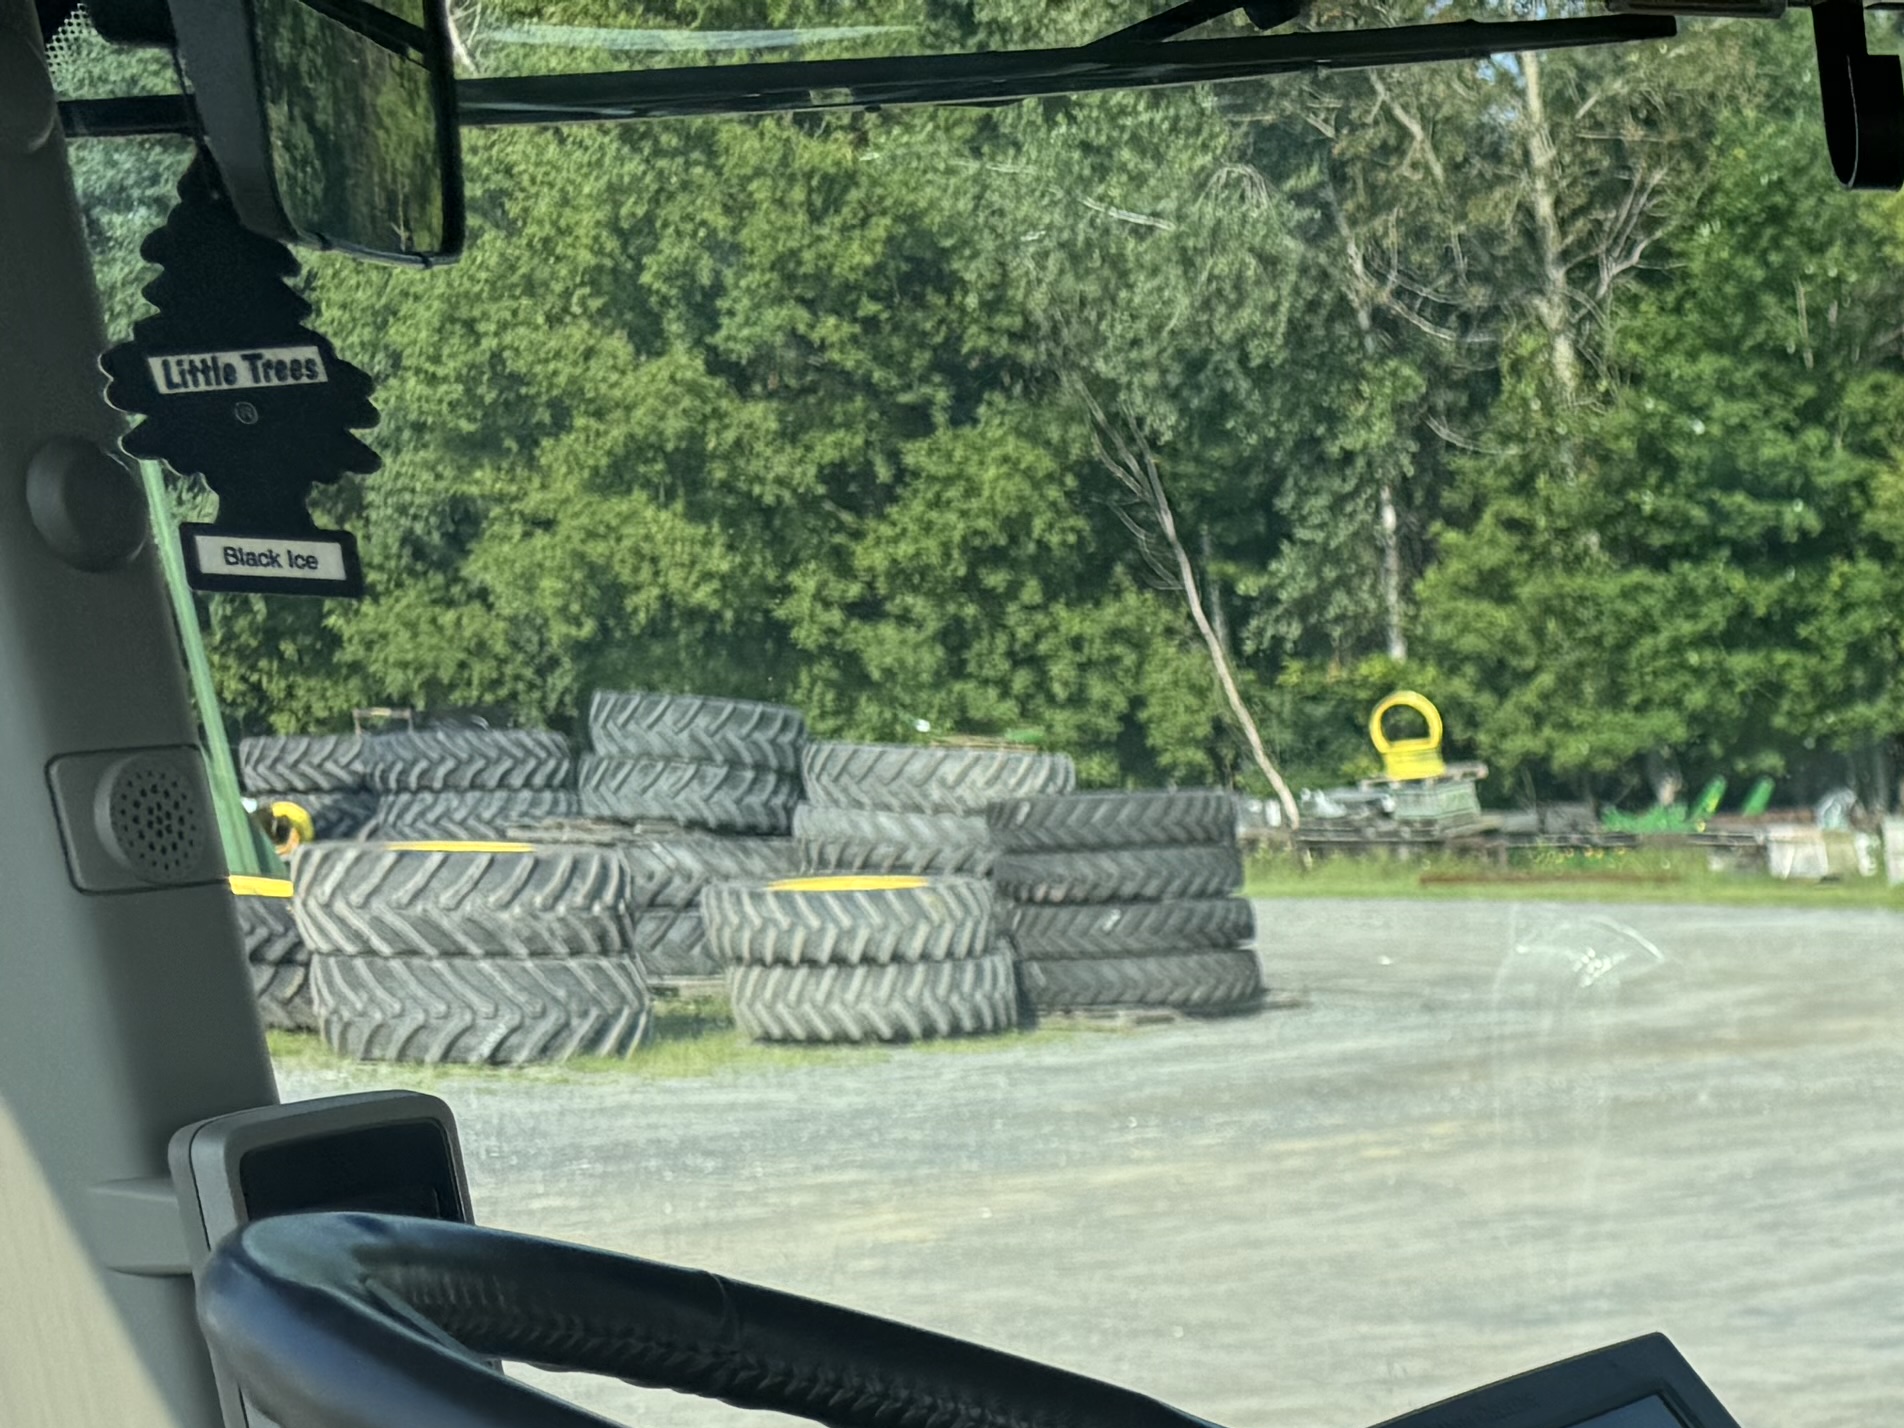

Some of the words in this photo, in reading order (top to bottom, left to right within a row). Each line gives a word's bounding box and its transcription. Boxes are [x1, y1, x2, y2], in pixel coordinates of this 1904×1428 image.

[161, 356, 238, 391] Little
[241, 353, 319, 383] Trees
[223, 546, 281, 568] Black
[288, 549, 318, 570] Ice
